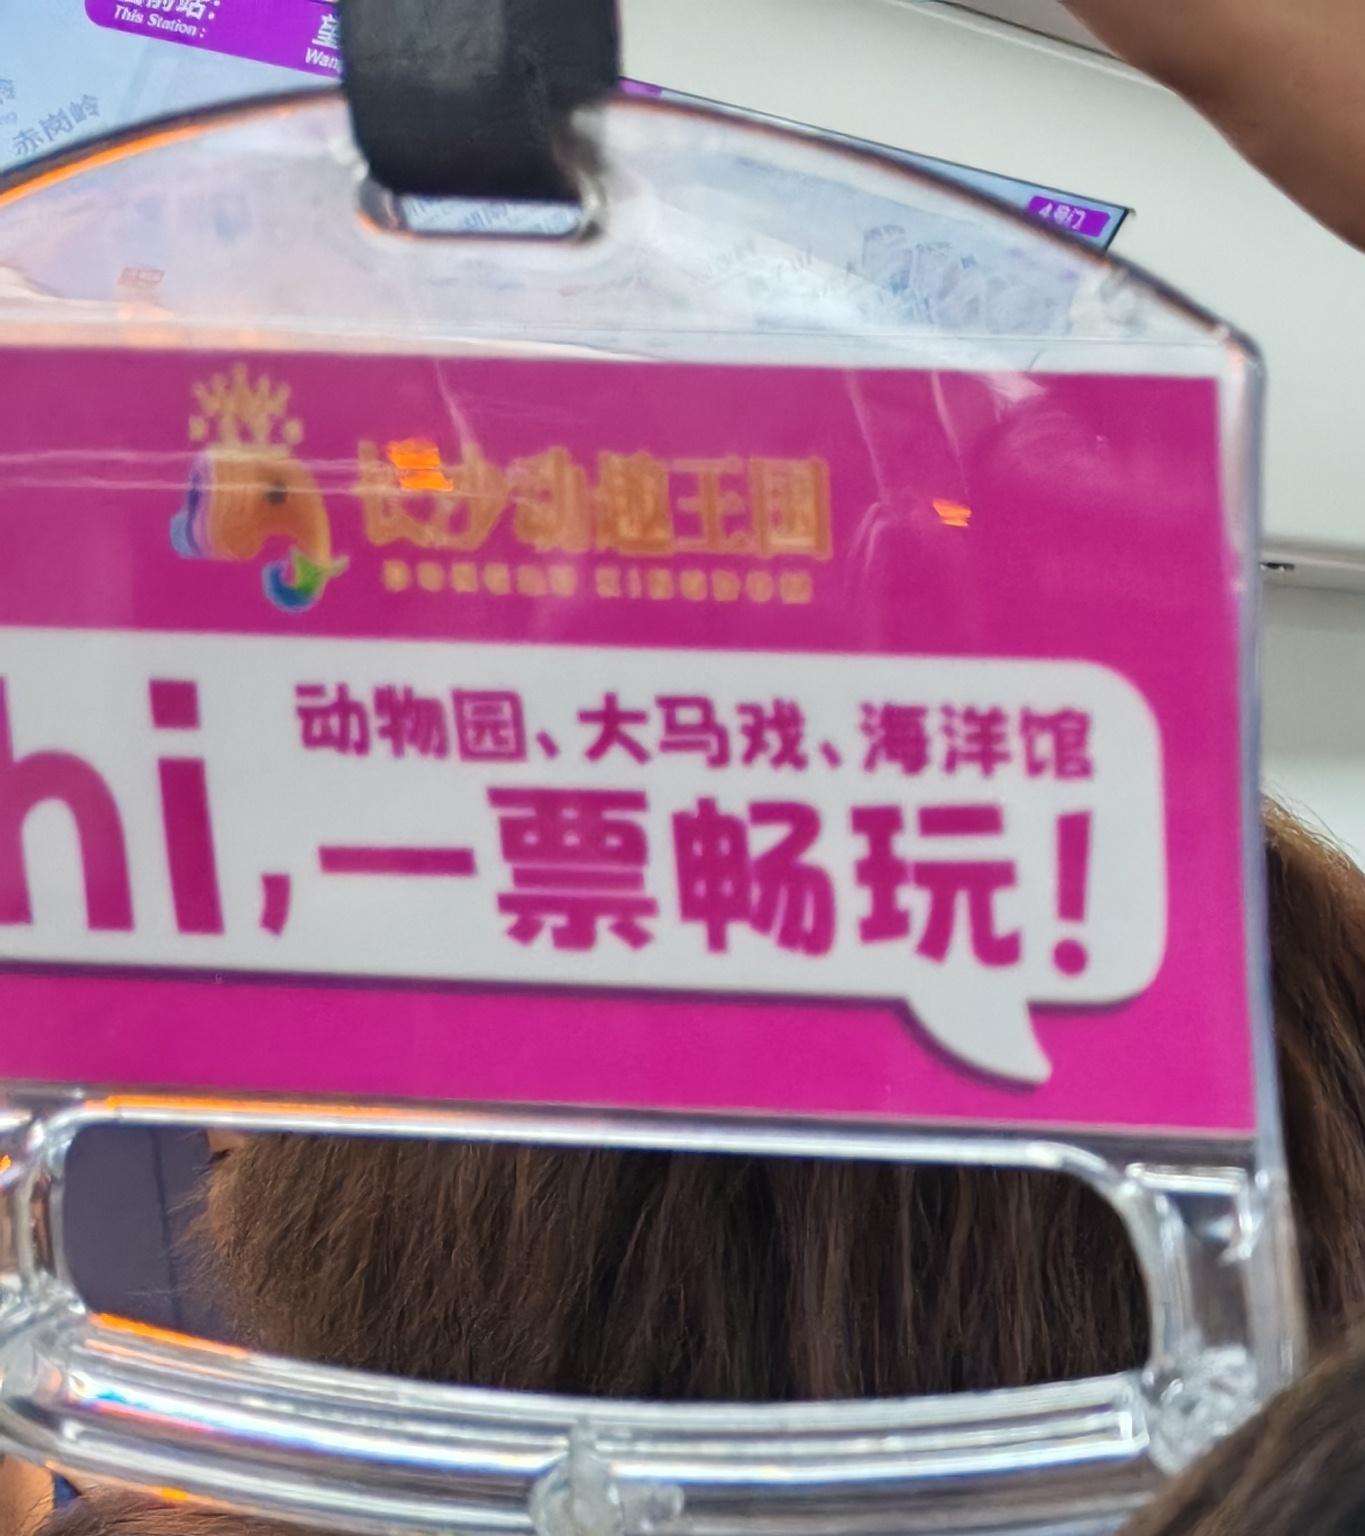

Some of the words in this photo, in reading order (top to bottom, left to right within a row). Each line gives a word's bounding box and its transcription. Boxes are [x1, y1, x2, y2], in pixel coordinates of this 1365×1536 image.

[114, 5, 144, 24] This
[294, 681, 1096, 782] 动物园、大马戏、海洋馆
